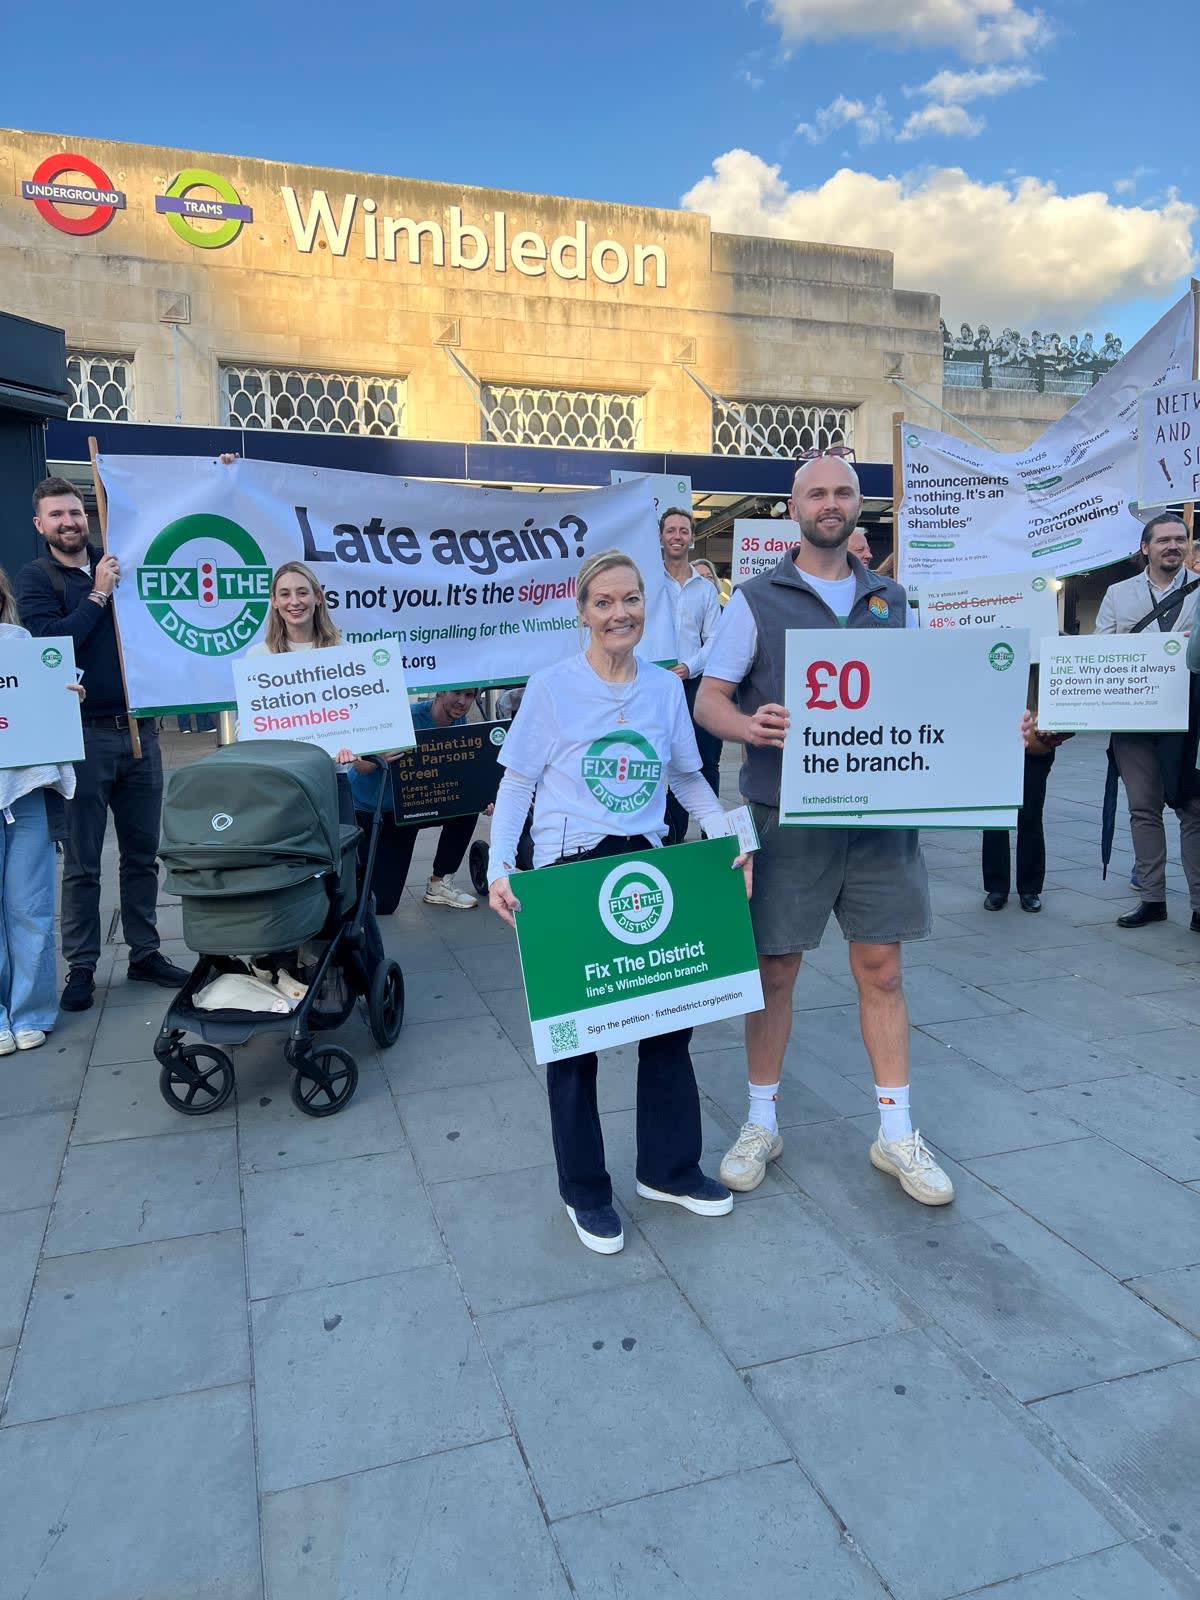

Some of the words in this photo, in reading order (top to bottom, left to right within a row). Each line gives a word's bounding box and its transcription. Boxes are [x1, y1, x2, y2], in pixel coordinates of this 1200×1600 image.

[26, 184, 119, 204] UNDERGROUND
[183, 200, 223, 217] TRAMS
[280, 186, 667, 288] Wimbledon
[1156, 421, 1191, 444] AND
[907, 463, 929, 474] "No
[907, 475, 1009, 489] announcements
[914, 490, 965, 502] nothing.
[966, 489, 986, 500] It's
[987, 489, 1004, 499] an
[907, 505, 960, 515] absolute
[1027, 499, 1124, 539] overcrowding"
[907, 517, 972, 529] shambles"
[295, 506, 422, 564] Late
[430, 515, 589, 575] again?
[741, 537, 760, 551] 35
[740, 556, 749, 565] of
[751, 556, 778, 567] signal
[752, 567, 761, 575] to
[141, 572, 192, 597] FIX
[221, 573, 269, 595] THE
[345, 585, 387, 609] not
[392, 589, 442, 613] you.
[446, 583, 477, 606] It's
[482, 582, 514, 605] the
[518, 577, 576, 606] signall
[929, 598, 968, 611] “Good
[971, 592, 1023, 607] Service”
[346, 629, 407, 644] modern
[410, 624, 477, 644] signalling
[480, 622, 497, 637] for
[500, 620, 520, 635] the
[522, 616, 579, 633] Wimbled
[930, 616, 955, 628] 48%
[959, 614, 971, 626] of
[974, 614, 996, 624] our
[160, 608, 260, 654] DISTRICT
[1074, 655, 1095, 664] THE
[1098, 654, 1147, 663] DISTRICT
[248, 661, 366, 689] “Southfields
[1050, 666, 1077, 675] LINE.
[1079, 666, 1101, 676] Why
[1103, 665, 1129, 674] does
[1131, 664, 1138, 673] it
[1140, 664, 1176, 675] always
[805, 660, 871, 710] £0
[1050, 678, 1063, 688] go
[1065, 677, 1092, 685] down
[1095, 676, 1104, 685] in
[1106, 676, 1126, 686] any
[1127, 675, 1148, 684] sort
[1050, 687, 1059, 696] of
[1061, 687, 1101, 696] extreme
[1104, 685, 1160, 695] weather?!”
[251, 690, 316, 711] station
[321, 678, 390, 702] closed.
[253, 702, 359, 732] Shambles”
[803, 725, 883, 747] funded
[889, 726, 912, 745] to
[918, 724, 945, 744] fix
[399, 757, 415, 768] at
[422, 751, 475, 765] Parsons
[583, 760, 614, 776] FIX
[631, 764, 660, 778] THE
[803, 753, 839, 774] the
[846, 752, 931, 772] branch.
[400, 768, 439, 781] Green
[592, 783, 651, 811] DISTRICT
[802, 794, 869, 805] fixthedistrict.org
[610, 898, 631, 912] FIX
[641, 893, 662, 906] THE
[618, 909, 660, 932] DISTRICT
[584, 963, 611, 981] Fix
[613, 956, 645, 974] The
[649, 940, 705, 967] District
[586, 983, 614, 998] line's
[616, 970, 673, 990] Wimbledon
[674, 961, 709, 977] branch
[587, 1024, 606, 1034] Sign
[607, 1020, 620, 1029] the
[621, 1012, 650, 1027] petition
[655, 990, 743, 1017] fixthedistrict.org/petition
